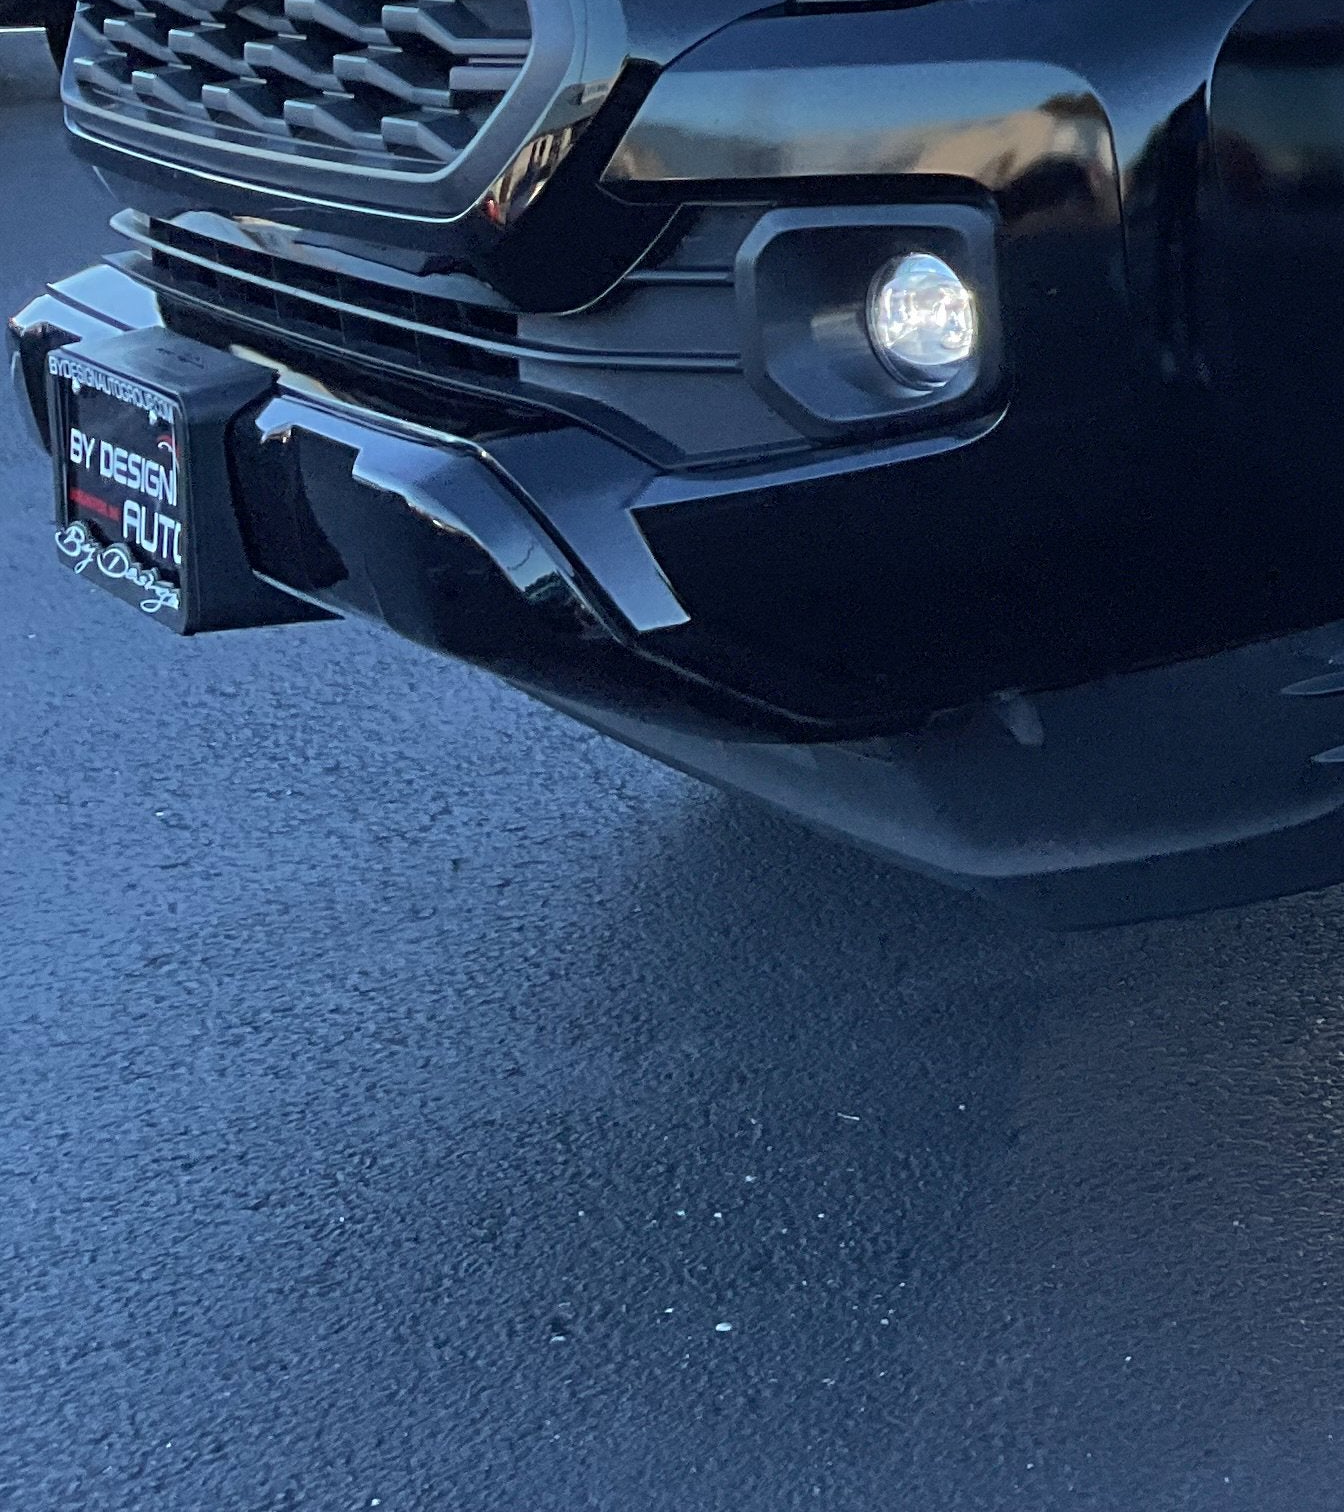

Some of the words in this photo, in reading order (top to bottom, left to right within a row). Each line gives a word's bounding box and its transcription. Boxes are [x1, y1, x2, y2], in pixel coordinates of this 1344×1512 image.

[70, 427, 95, 470] BY
[100, 439, 177, 507] DESIGN
[54, 522, 98, 575] By
